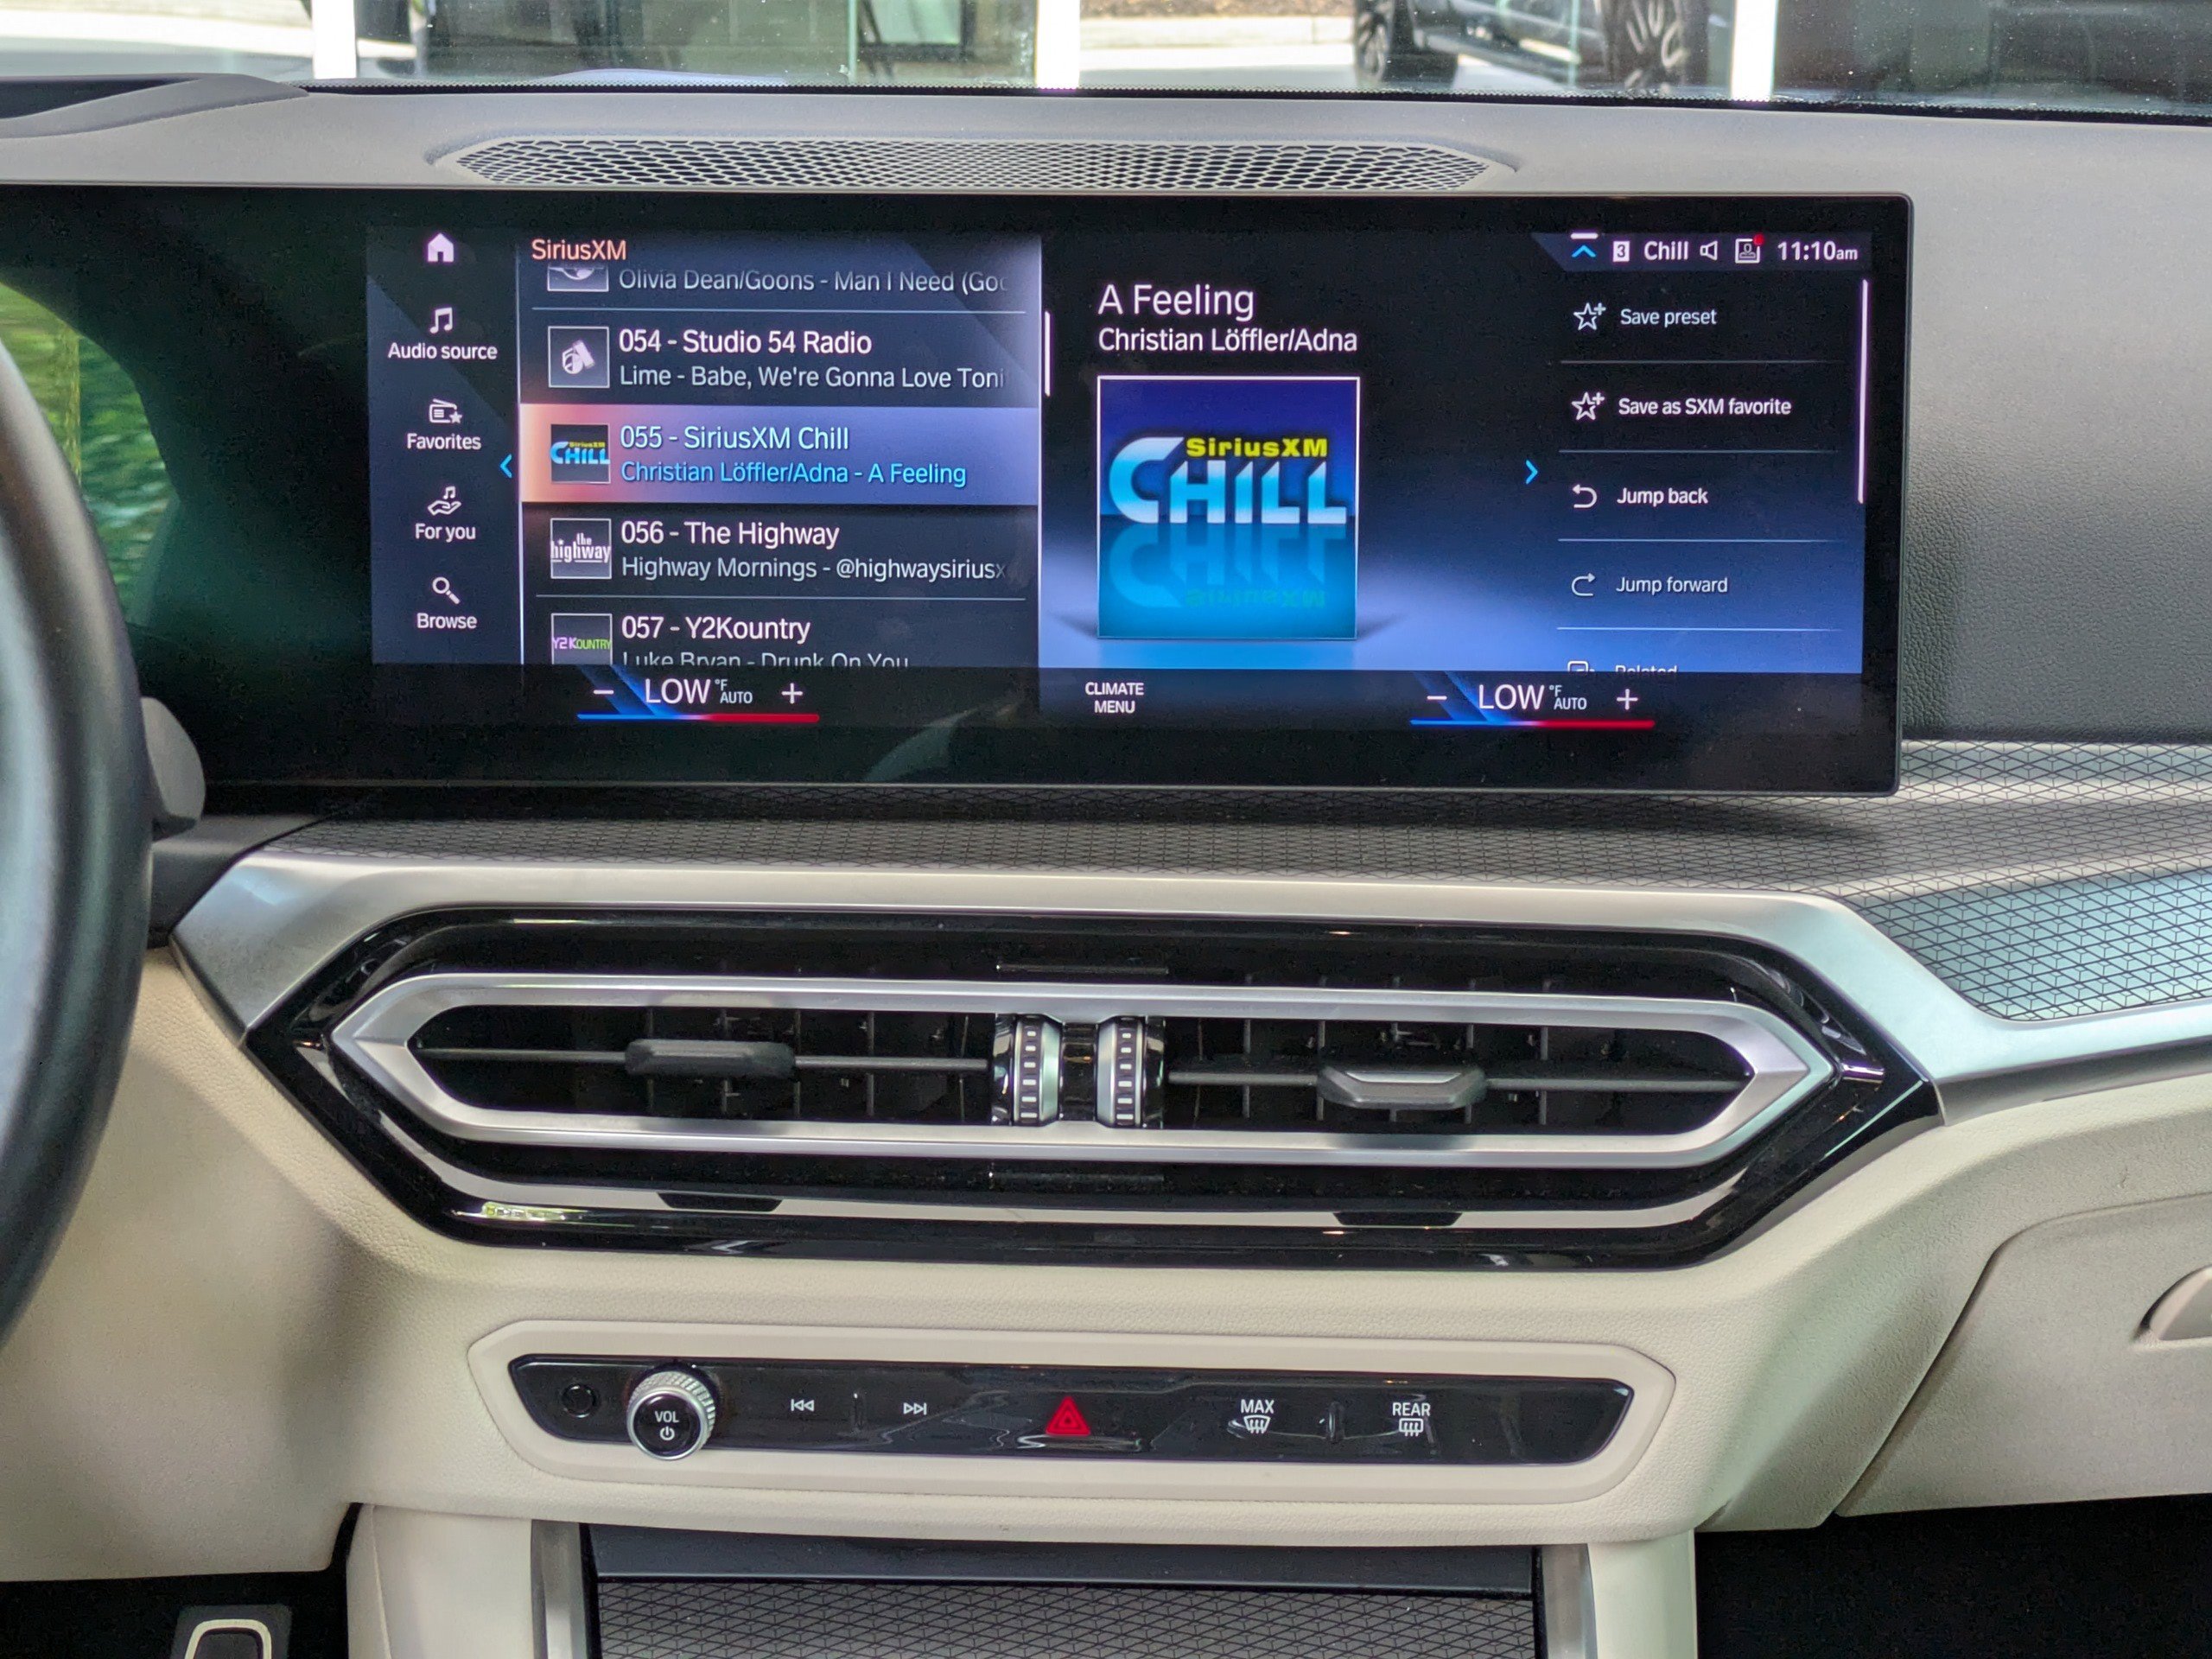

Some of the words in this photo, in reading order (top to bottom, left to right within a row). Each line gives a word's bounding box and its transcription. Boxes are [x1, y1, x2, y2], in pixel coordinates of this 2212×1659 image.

[531, 238, 627, 262] SiriusXM
[1644, 240, 1688, 260] Chill
[1777, 241, 1858, 261] 11:10am
[619, 268, 677, 289] Olivia
[684, 270, 815, 291] Dean/Goons
[835, 271, 880, 291] Man
[899, 271, 954, 291] Need
[1098, 284, 1122, 315] A
[1134, 284, 1255, 321] Feeling
[1620, 308, 1660, 326] Save
[1664, 308, 1717, 328] preset
[619, 328, 661, 353] 054
[683, 329, 761, 353] Studio
[768, 331, 796, 353] 54
[804, 331, 872, 354] Radio
[1098, 327, 1204, 352] Christian
[1211, 329, 1357, 353] Löffler/Adna
[387, 342, 437, 360] Audio
[441, 345, 499, 361] source
[620, 365, 671, 385] Lime
[691, 366, 752, 390] Babe,
[758, 367, 820, 387] We're
[825, 367, 895, 387] Gonna
[902, 368, 952, 388] Love
[1618, 398, 1658, 416] Save
[1662, 401, 1681, 416] as
[1685, 398, 1725, 416] SXM
[1729, 397, 1792, 416] favorite
[407, 433, 481, 450] Favorites
[620, 425, 663, 448] 055
[684, 426, 791, 449] SiriusXM
[798, 426, 849, 450] Chill
[1185, 438, 1327, 457] SiriusXM
[621, 461, 714, 482] Christian
[721, 461, 849, 483] Löffler/Adna
[868, 463, 885, 483] A
[891, 463, 967, 488] Feeling
[1109, 436, 1346, 524] CHILL
[1617, 487, 1664, 507] Jump
[1669, 487, 1709, 504] back
[415, 523, 442, 539] For
[446, 525, 476, 543] you
[576, 532, 593, 545] the
[621, 520, 664, 543] 056
[683, 521, 731, 544] The
[739, 522, 840, 550] Highway
[550, 538, 611, 563] highway
[622, 556, 711, 581] Highway
[717, 558, 817, 582] Mornings
[836, 559, 1007, 582] @highwaysiriusx
[1616, 577, 1662, 595] Jump
[1667, 576, 1728, 593] forward
[416, 613, 478, 629] Browse
[621, 615, 664, 639] 057
[685, 616, 810, 644] Y2Kountry
[623, 652, 674, 666] Luke
[645, 678, 711, 704] LOW
[720, 692, 753, 704] AUTO
[1084, 682, 1144, 696] CLIMATE
[1478, 684, 1545, 710] LOW
[1094, 700, 1135, 714] MENU
[1554, 696, 1587, 710] AUTO
[654, 1410, 679, 1423] VOL
[1240, 1399, 1274, 1414] MAX
[1392, 1402, 1431, 1417] REAR
